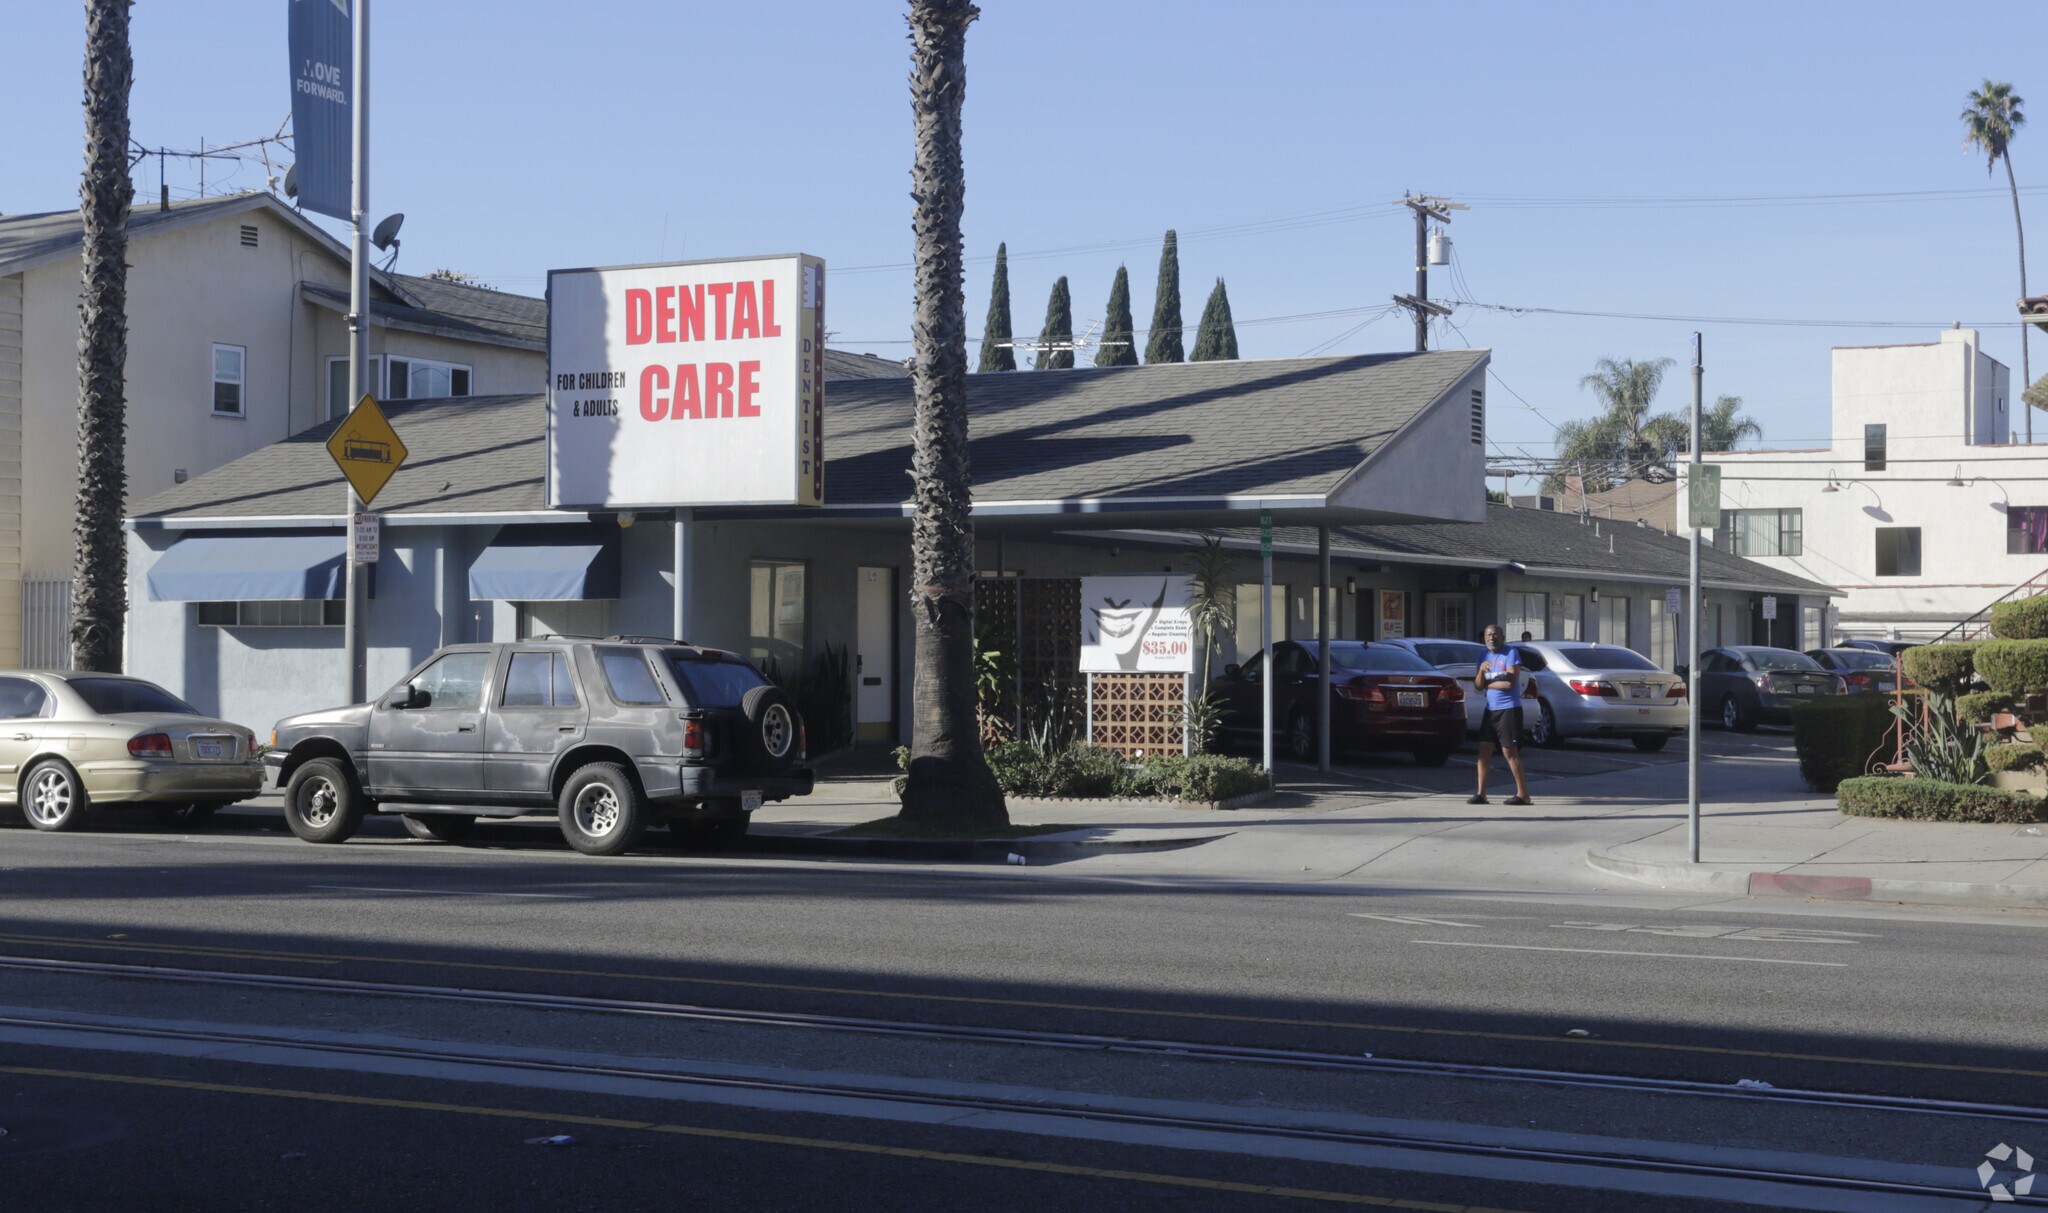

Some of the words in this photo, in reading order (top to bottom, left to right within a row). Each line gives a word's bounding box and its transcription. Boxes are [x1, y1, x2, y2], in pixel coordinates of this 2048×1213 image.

[296, 78, 346, 105] FORWARD.
[625, 279, 781, 345] DENTAL
[557, 373, 575, 391] FOR
[578, 371, 626, 390] CHILDREN
[639, 360, 761, 422] CARE
[573, 400, 580, 418] &
[583, 399, 618, 417] ADULTS
[802, 338, 811, 475] DENTIST
[1142, 640, 1188, 656] $35.00
